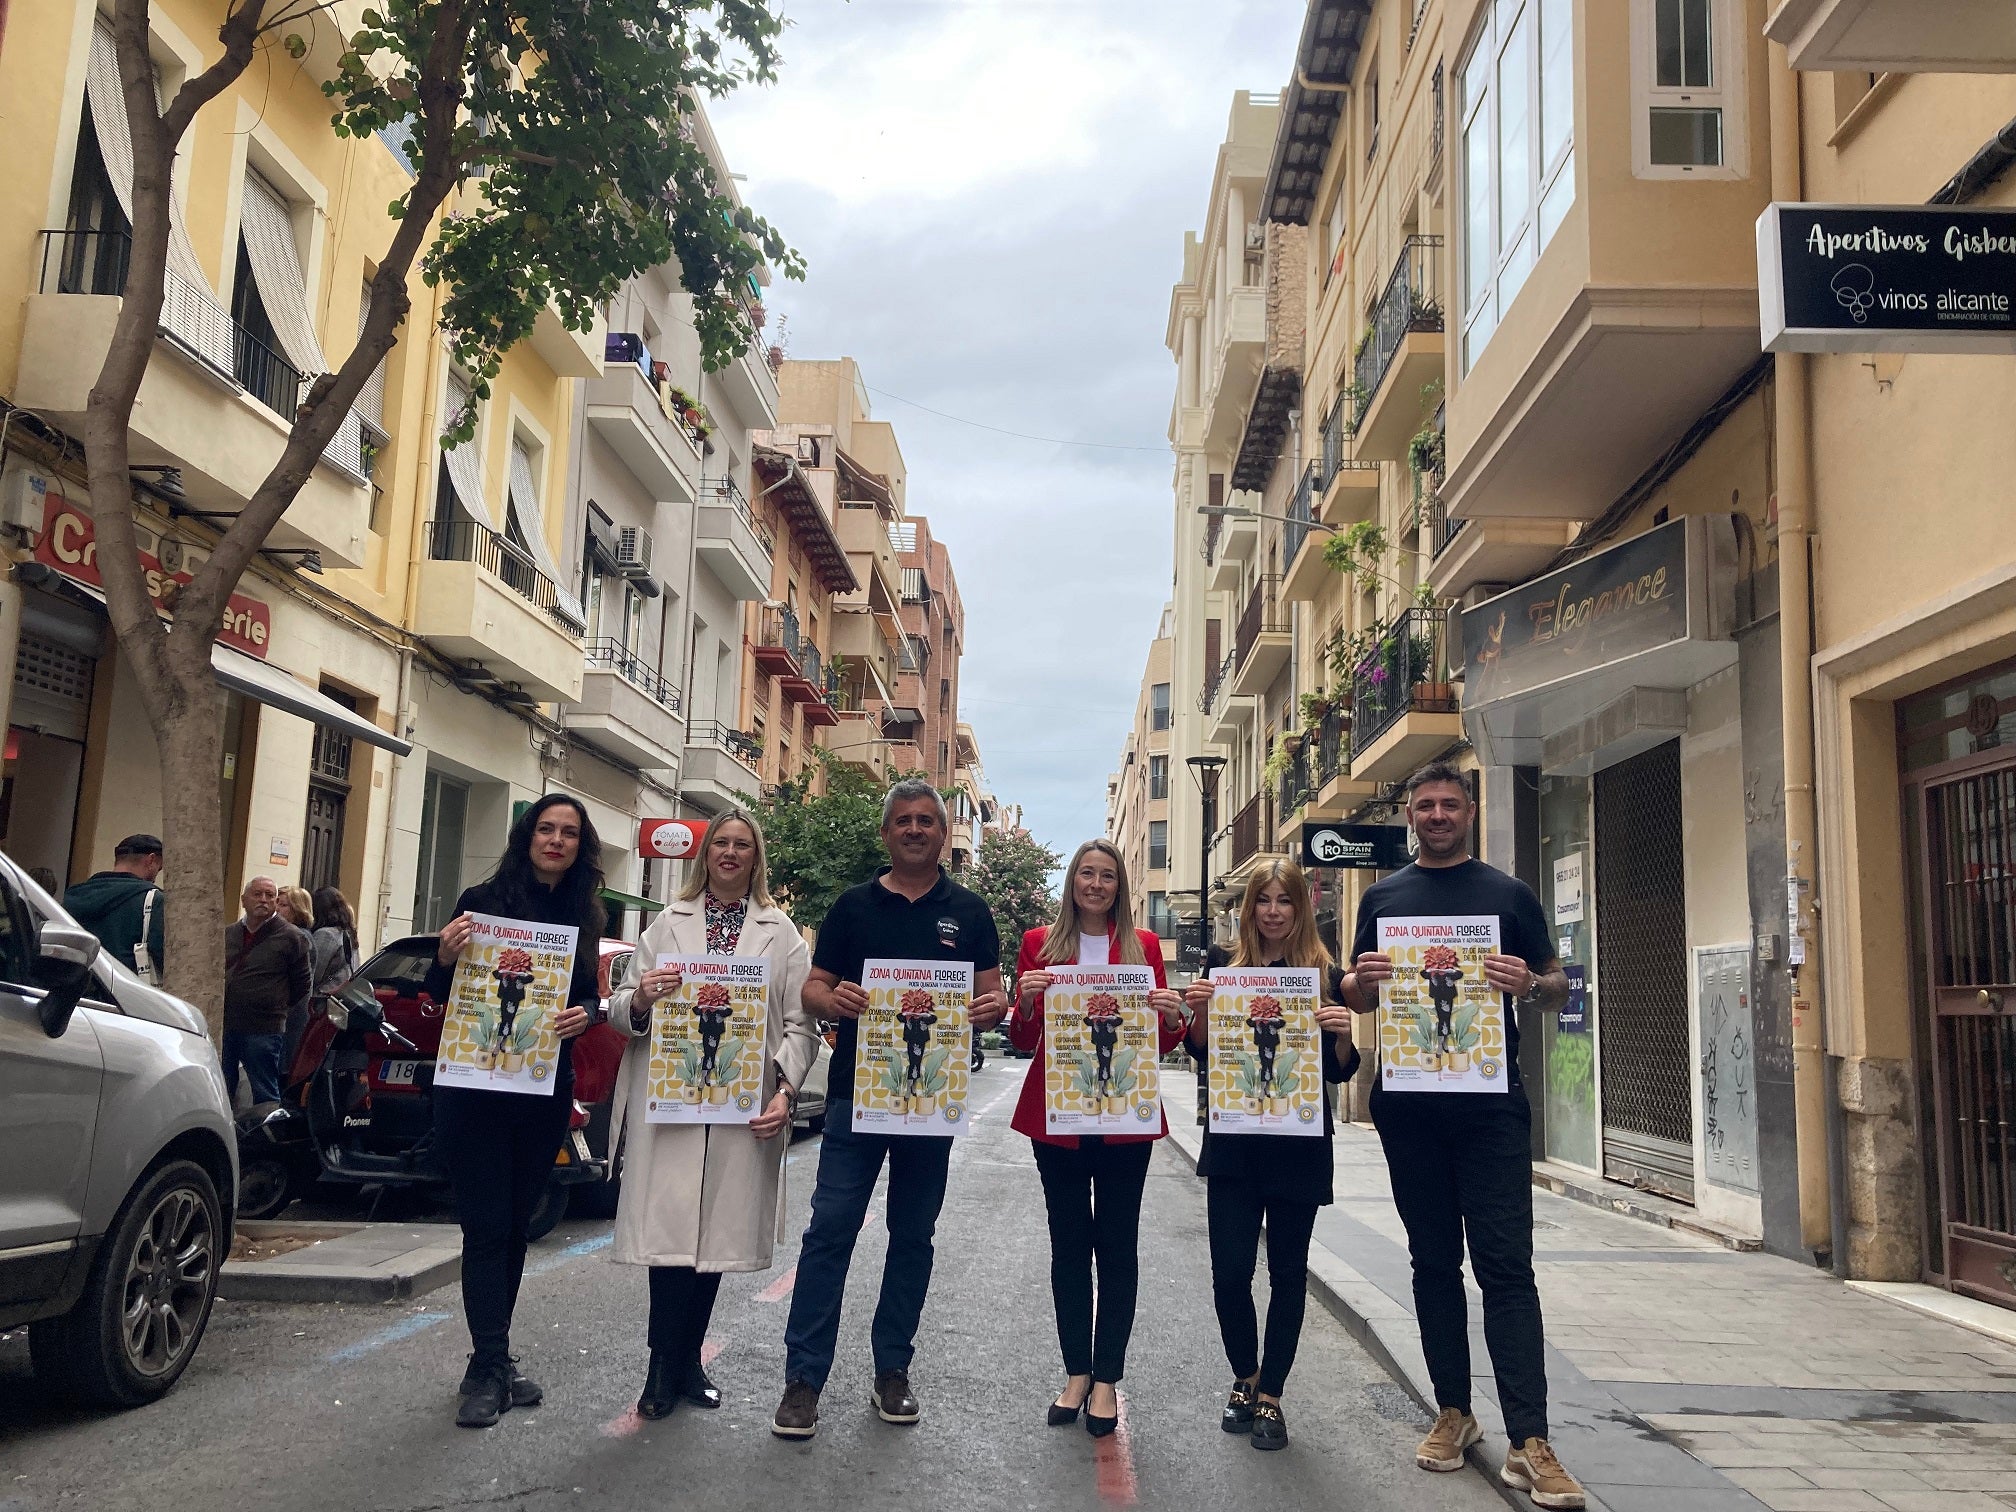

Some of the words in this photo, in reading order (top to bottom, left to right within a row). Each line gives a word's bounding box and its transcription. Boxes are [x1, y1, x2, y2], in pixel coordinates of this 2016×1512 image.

[1805, 223, 1930, 259] Aperitivos
[1878, 288, 1927, 310] vinos
[1936, 288, 2009, 311] alicante
[1529, 566, 1666, 653] Elegance
[1324, 845, 1341, 855] RO
[471, 922, 490, 935] ZONA
[493, 926, 532, 941] QUINTANA
[535, 932, 570, 945] FLORECE
[1385, 926, 1408, 937] ZONA
[1412, 926, 1453, 938] QUINTANA
[1457, 925, 1491, 935] FLORECE
[690, 963, 728, 975] QUINTANA
[731, 965, 763, 976] FLORECE
[870, 968, 890, 979] ZONA
[893, 968, 931, 981] QUINTANA
[935, 970, 966, 981] FLORECE
[1052, 974, 1074, 984] ZONA
[1077, 974, 1115, 986] QUINTANA
[1118, 974, 1148, 984] FLORECE
[1216, 976, 1236, 986] ZONA
[1240, 976, 1277, 988] QUINTANA
[1280, 977, 1312, 986] FLORECE
